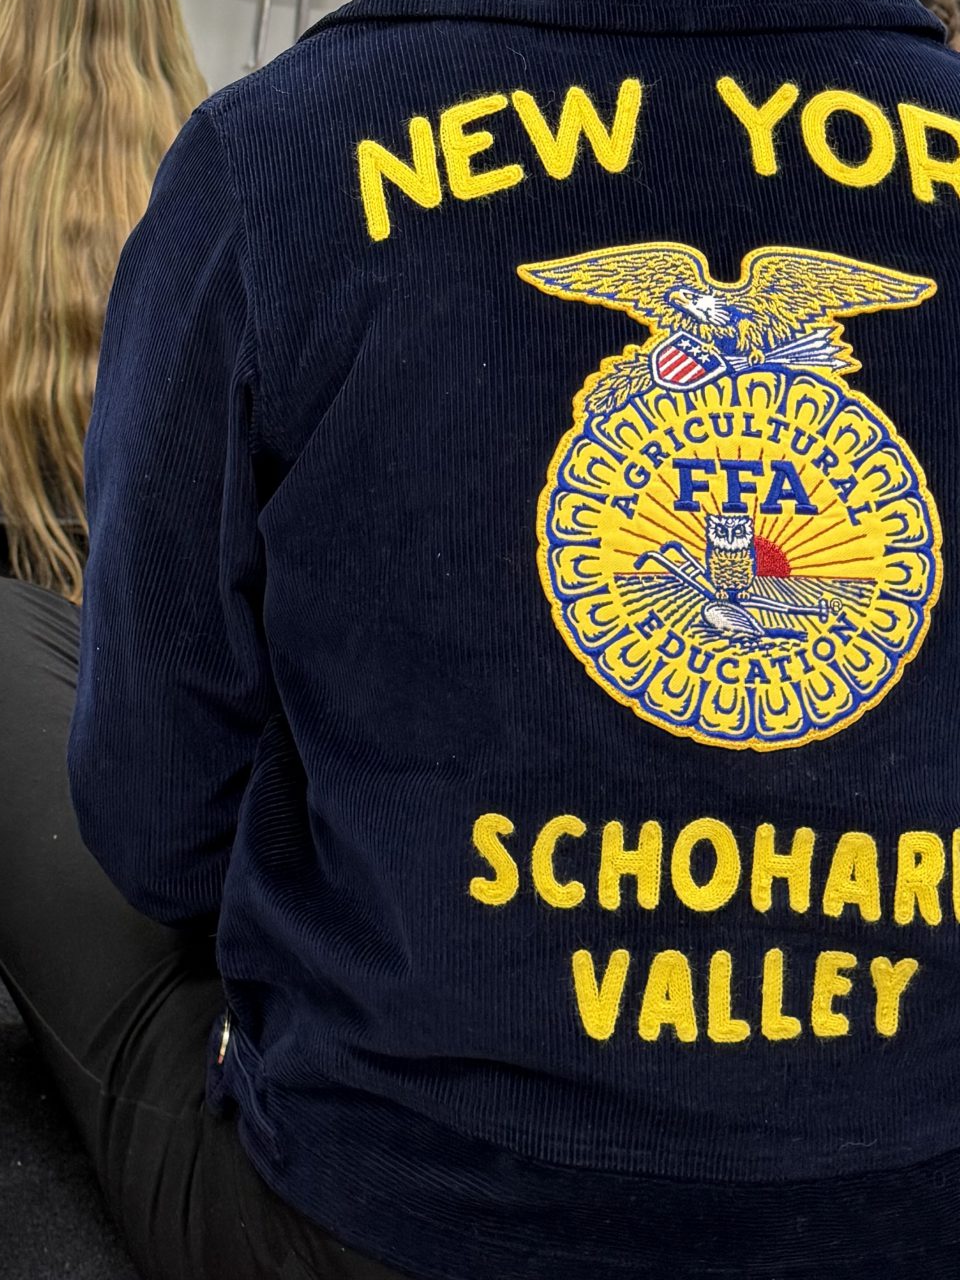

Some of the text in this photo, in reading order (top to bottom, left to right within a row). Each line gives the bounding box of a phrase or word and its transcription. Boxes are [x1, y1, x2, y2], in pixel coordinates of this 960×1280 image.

[358, 78, 642, 241] NEW
[611, 412, 874, 526] AGRICULTURAL
[672, 458, 819, 516] FFA
[636, 610, 859, 685] EDUCATION
[572, 947, 920, 1043] VALLEY
